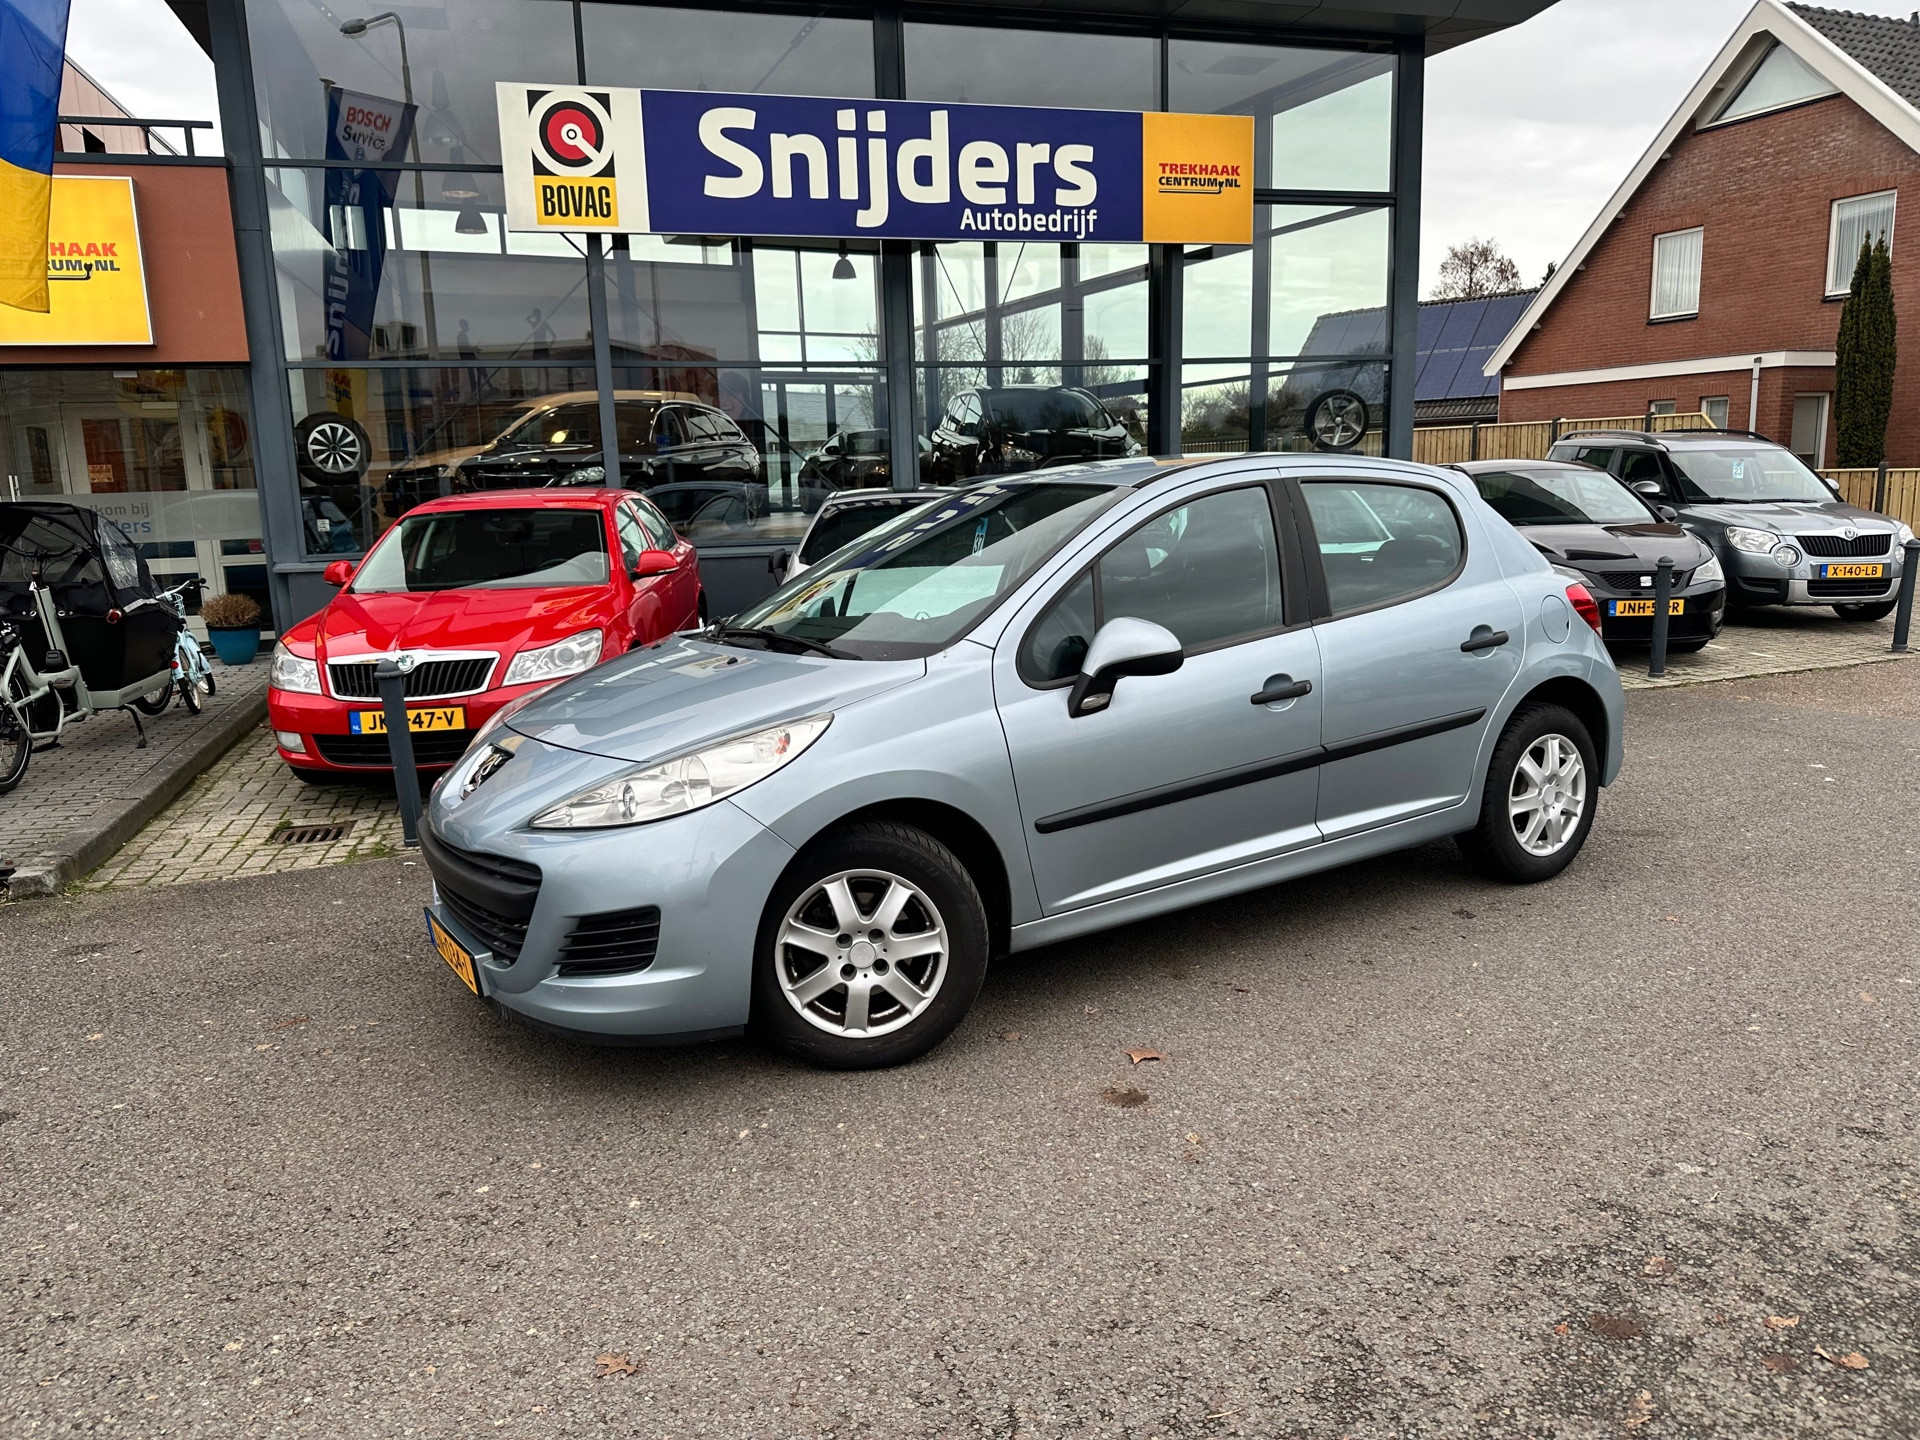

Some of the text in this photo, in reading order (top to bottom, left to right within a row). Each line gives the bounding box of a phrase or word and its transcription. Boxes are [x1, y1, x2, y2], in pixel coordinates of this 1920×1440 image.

[345, 106, 392, 133] BOSCH
[698, 106, 1098, 229] Snijders
[1158, 162, 1241, 176] TREKHAAK
[541, 184, 612, 218] BOVAG
[960, 208, 1098, 239] Autobedrijf
[1734, 467, 1743, 475] 23
[131, 503, 150, 518] bij
[973, 533, 984, 554] 37
[1831, 566, 1878, 576] X-140-LB
[1619, 602, 1679, 614] JNH-5-R
[368, 710, 455, 731] JK-47-V
